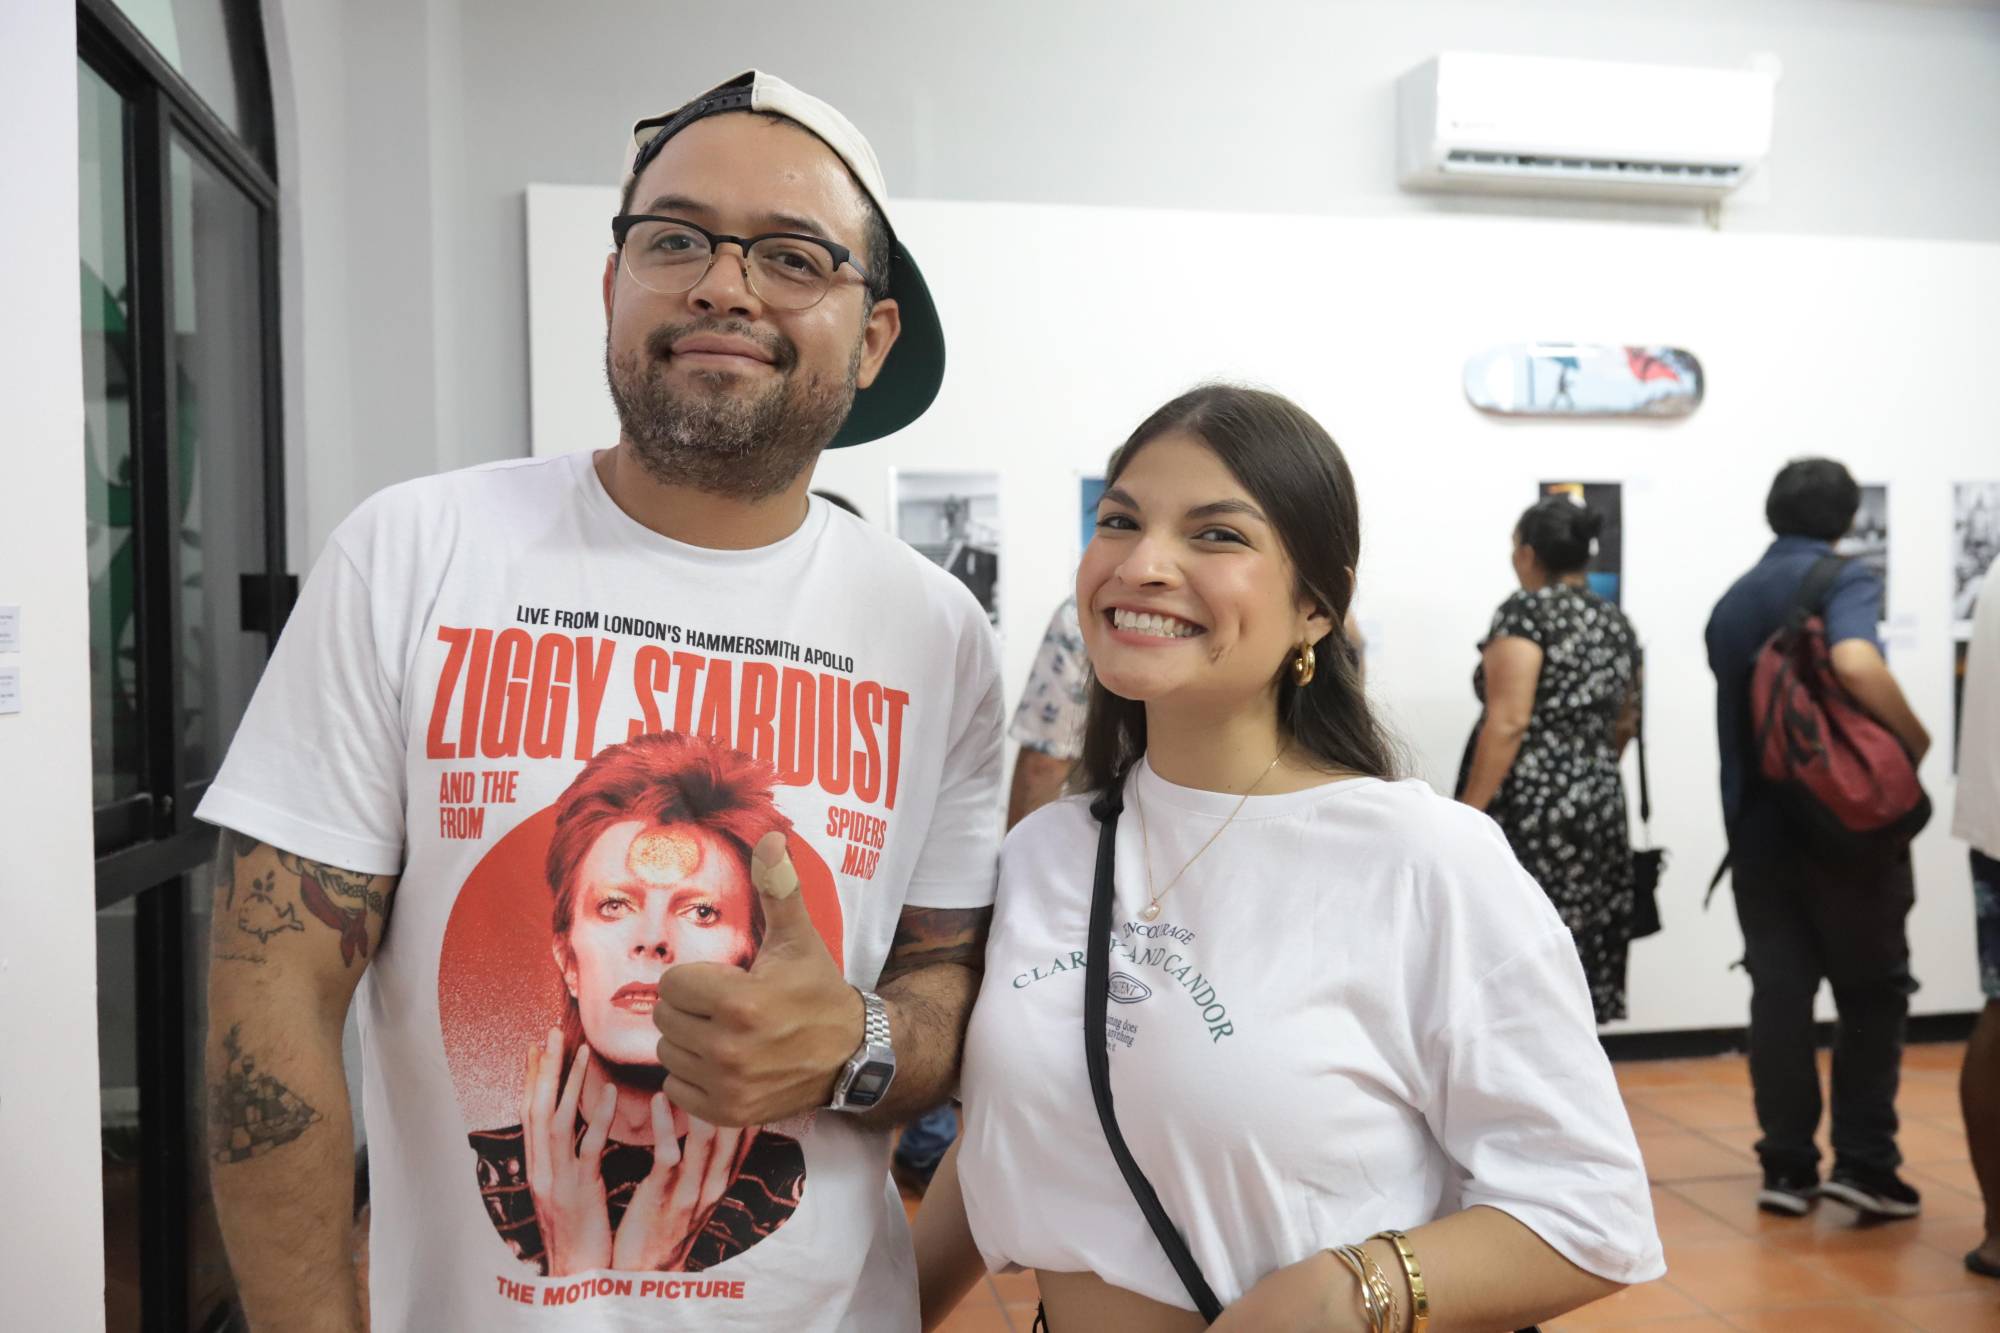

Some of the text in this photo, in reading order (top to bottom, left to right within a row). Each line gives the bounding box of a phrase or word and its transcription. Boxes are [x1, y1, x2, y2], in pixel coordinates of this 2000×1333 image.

[516, 605, 854, 674] LIVE FROM LONDON'S HAMMERSMITH APOLLO
[426, 625, 910, 811] ZIGGY STARDUST
[439, 770, 519, 804] AND THE
[439, 807, 485, 840] FROM
[826, 805, 887, 850] SPIDERS
[840, 843, 880, 881] MARS
[1122, 921, 1196, 946] ENCOURAGE
[1012, 938, 1235, 1044] CLARY AND CANDOR
[496, 1276, 745, 1306] THE MOTION PICTURE
